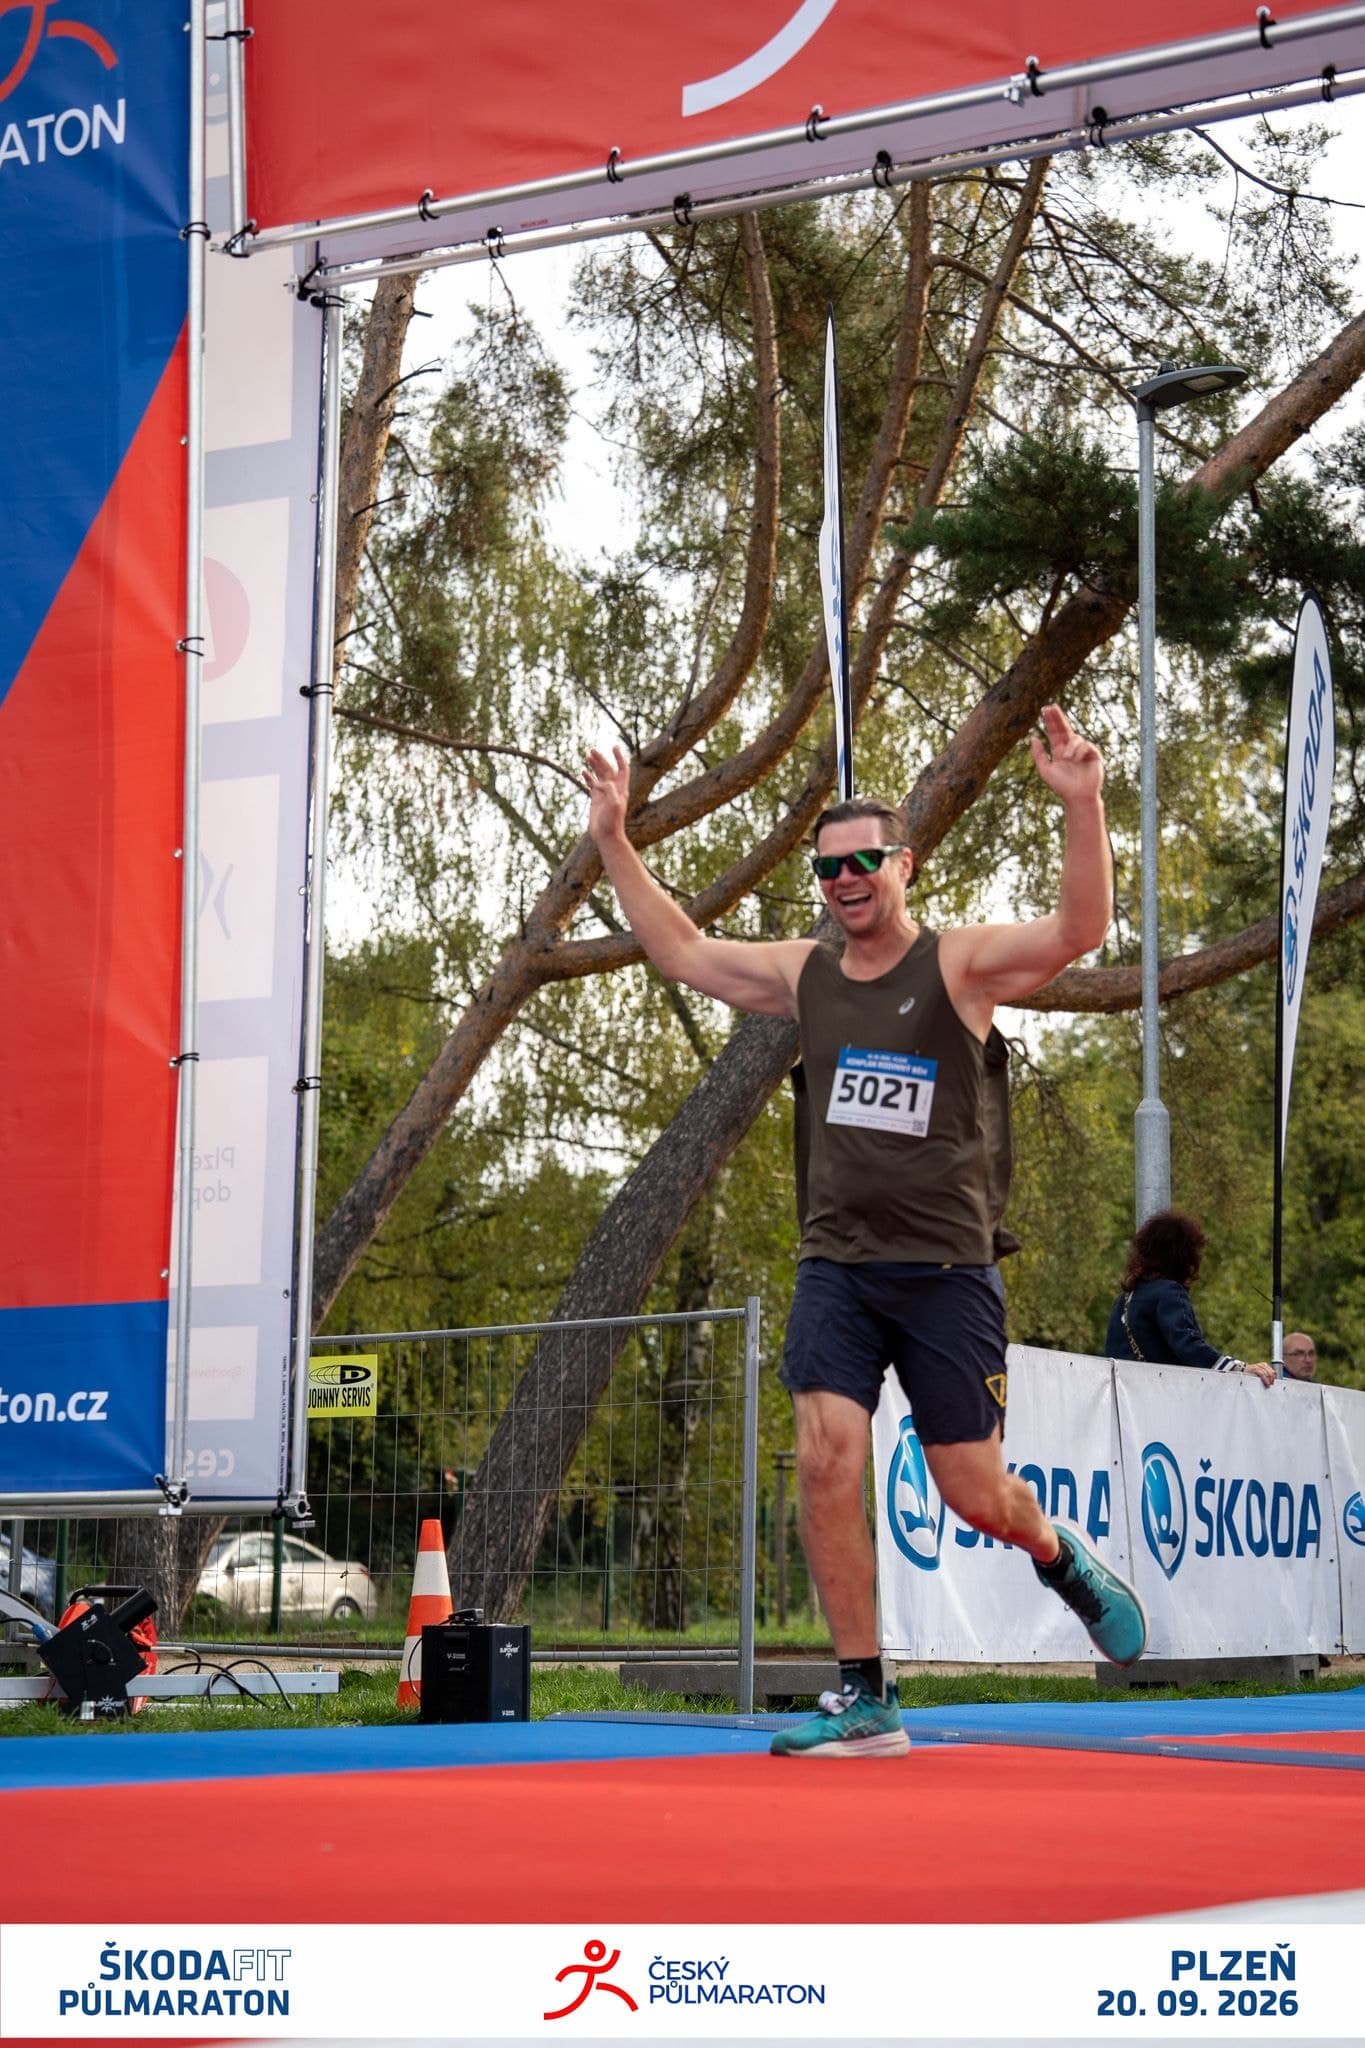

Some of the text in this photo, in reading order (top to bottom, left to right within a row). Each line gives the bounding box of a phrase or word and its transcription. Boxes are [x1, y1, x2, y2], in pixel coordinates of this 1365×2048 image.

[1293, 645, 1327, 897] ŠKODA
[837, 1073, 919, 1112] 5021
[307, 1386, 371, 1409] JOHNNY SERVIS
[1195, 1458, 1321, 1559] ŠKODA
